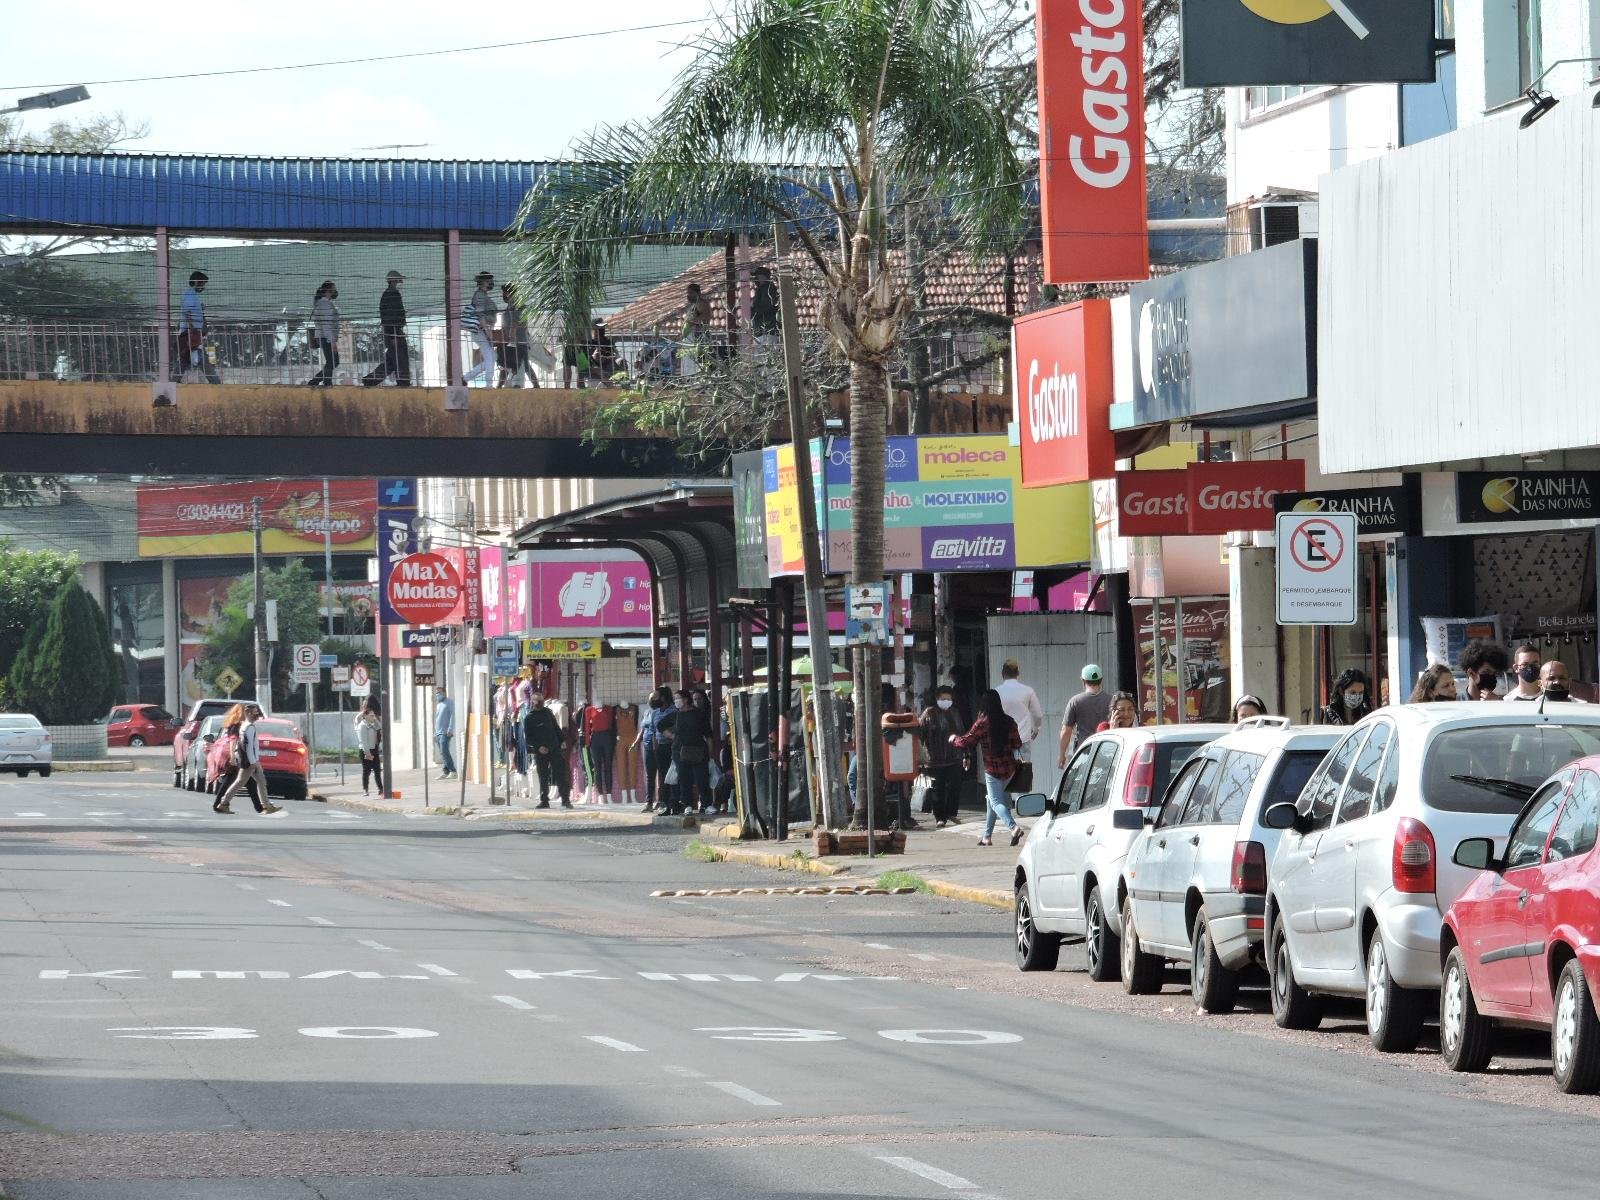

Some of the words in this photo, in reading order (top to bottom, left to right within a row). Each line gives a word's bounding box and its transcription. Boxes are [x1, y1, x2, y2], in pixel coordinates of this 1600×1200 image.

[1069, 0, 1130, 189] Gasto
[1028, 359, 1078, 443] Gaston
[924, 448, 1006, 465] moleca
[1521, 477, 1590, 497] RAINHA
[924, 491, 1007, 507] MOLEKINHO
[1124, 492, 1189, 516] Gast
[1328, 496, 1395, 513] RAINHA
[1522, 499, 1545, 511] DAS
[1548, 497, 1592, 510] NOIVAS
[1307, 529, 1326, 562] E
[393, 582, 458, 599] Modas
[1317, 587, 1352, 595] EMBARQUE
[302, 650, 311, 663] E
